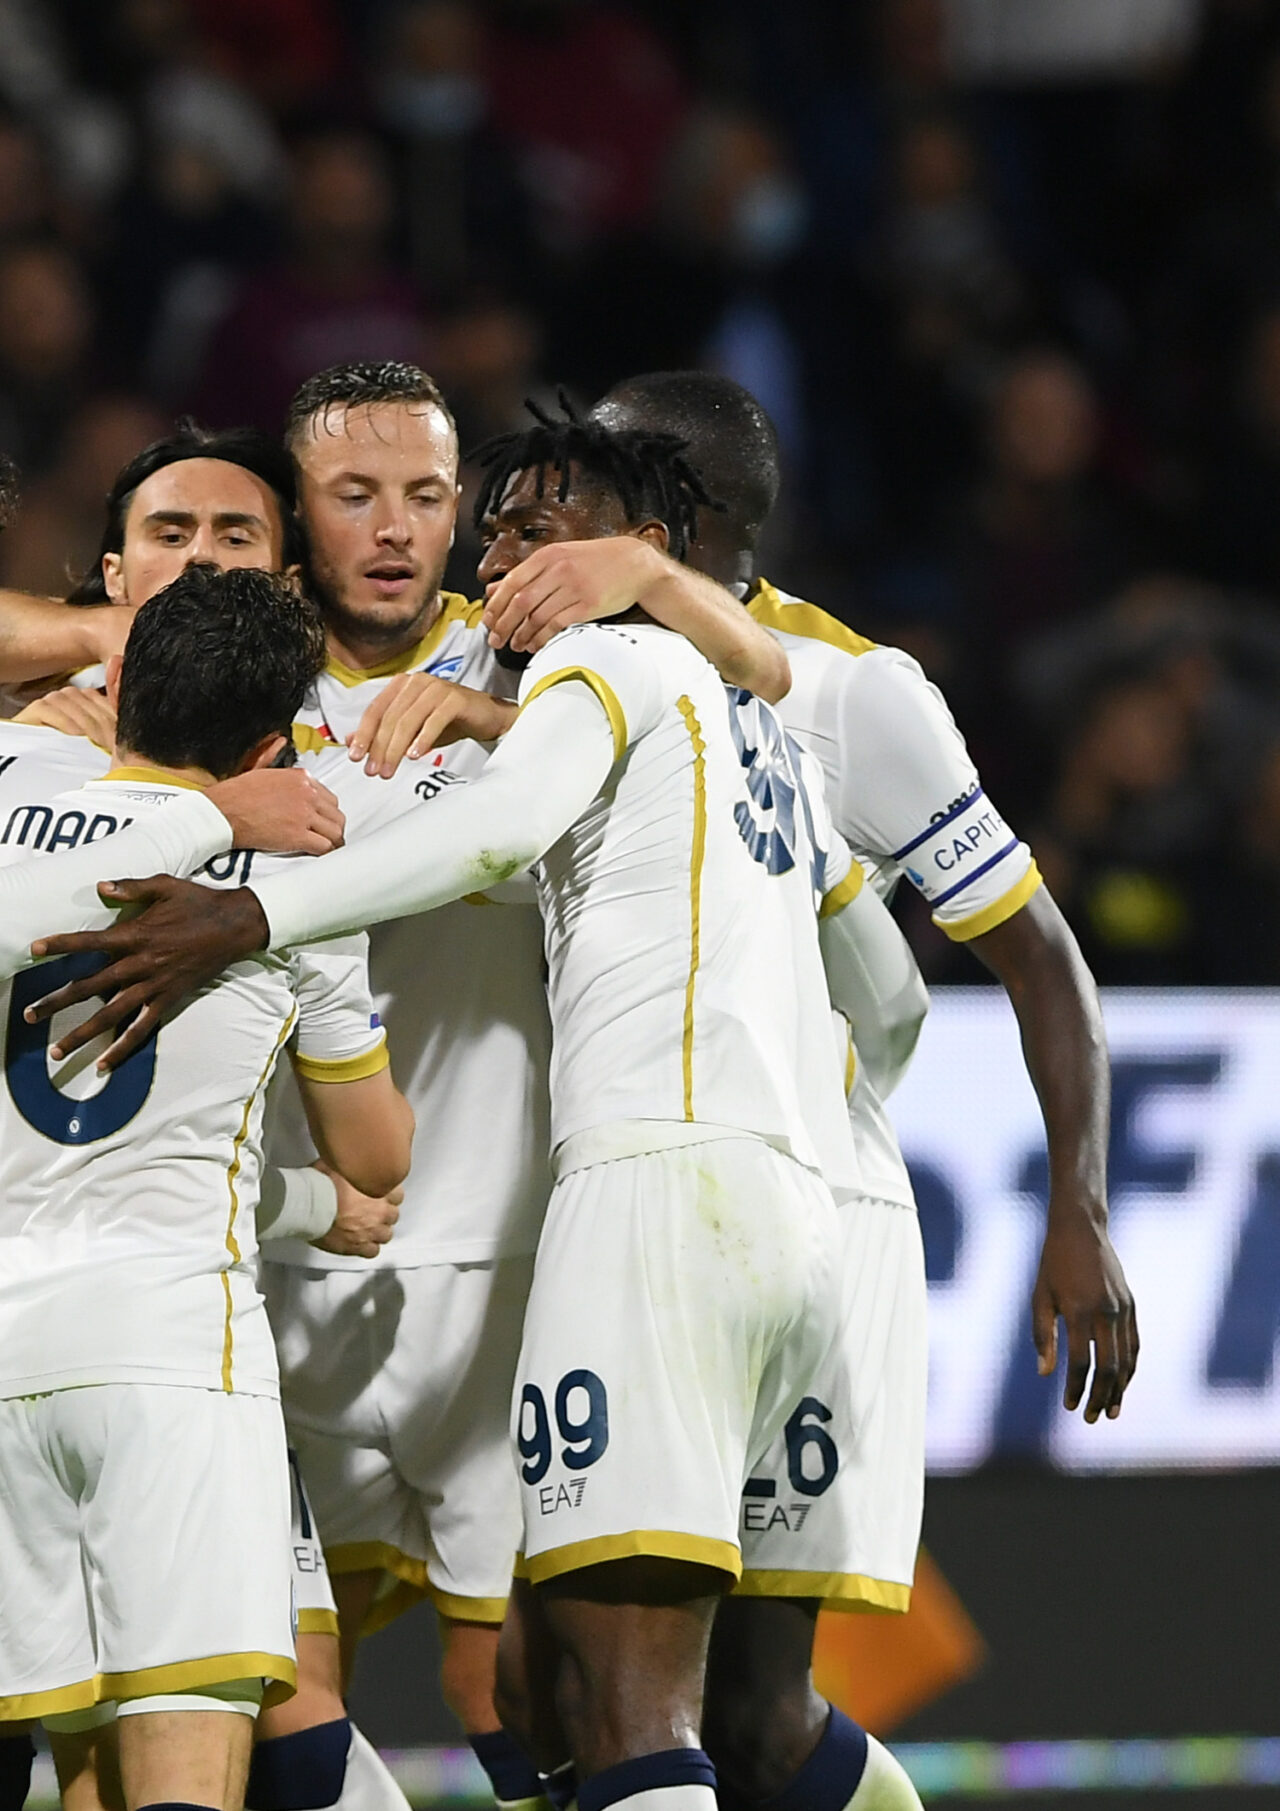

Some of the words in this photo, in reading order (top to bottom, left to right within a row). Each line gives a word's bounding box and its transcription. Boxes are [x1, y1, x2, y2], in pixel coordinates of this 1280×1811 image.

[0, 805, 134, 853] MAR
[933, 812, 1003, 871] CAPIT
[517, 1368, 609, 1486] 99
[538, 1476, 589, 1516] EA7
[744, 1502, 812, 1532] EA7
